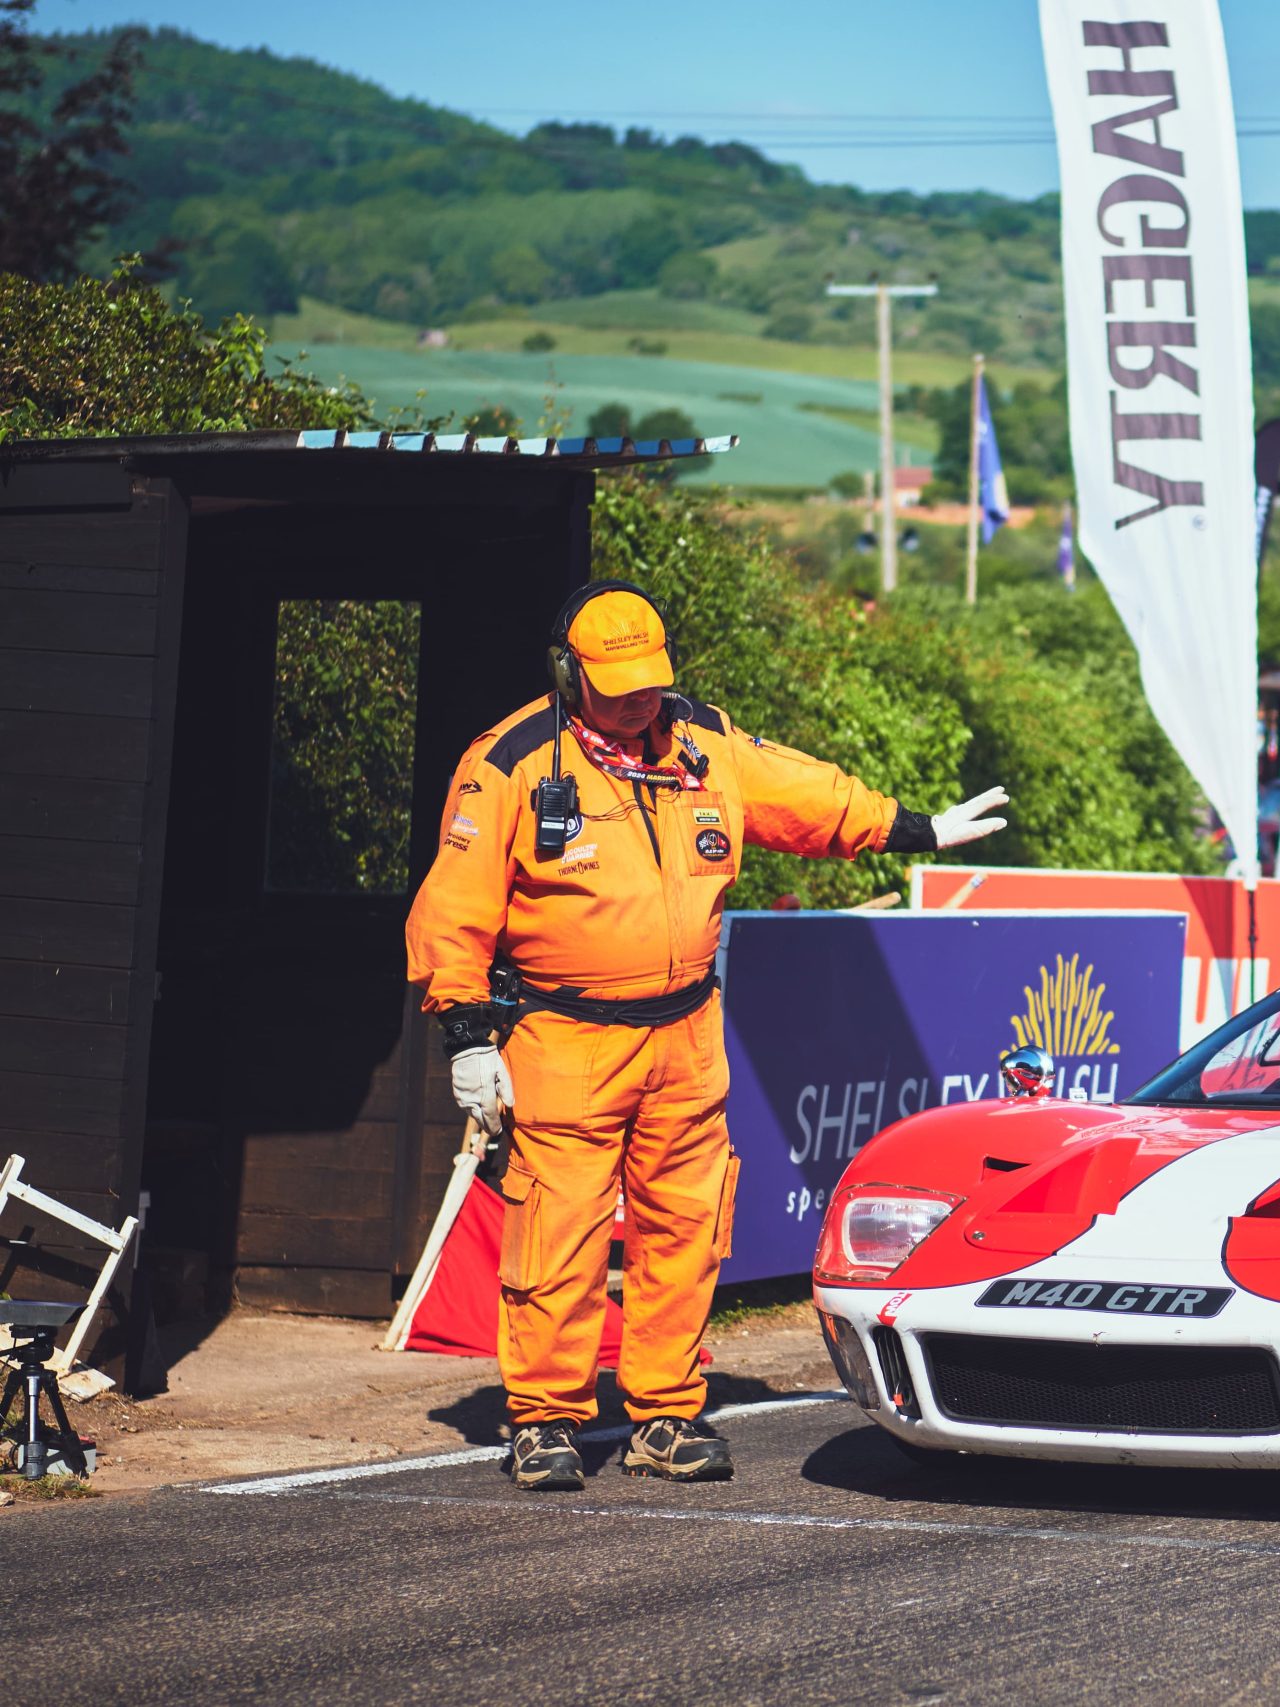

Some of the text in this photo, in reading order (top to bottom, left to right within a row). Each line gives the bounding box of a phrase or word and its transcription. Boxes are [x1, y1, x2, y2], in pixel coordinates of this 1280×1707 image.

[786, 1186, 834, 1222] spe
[1000, 1281, 1207, 1314] M40 GTR
